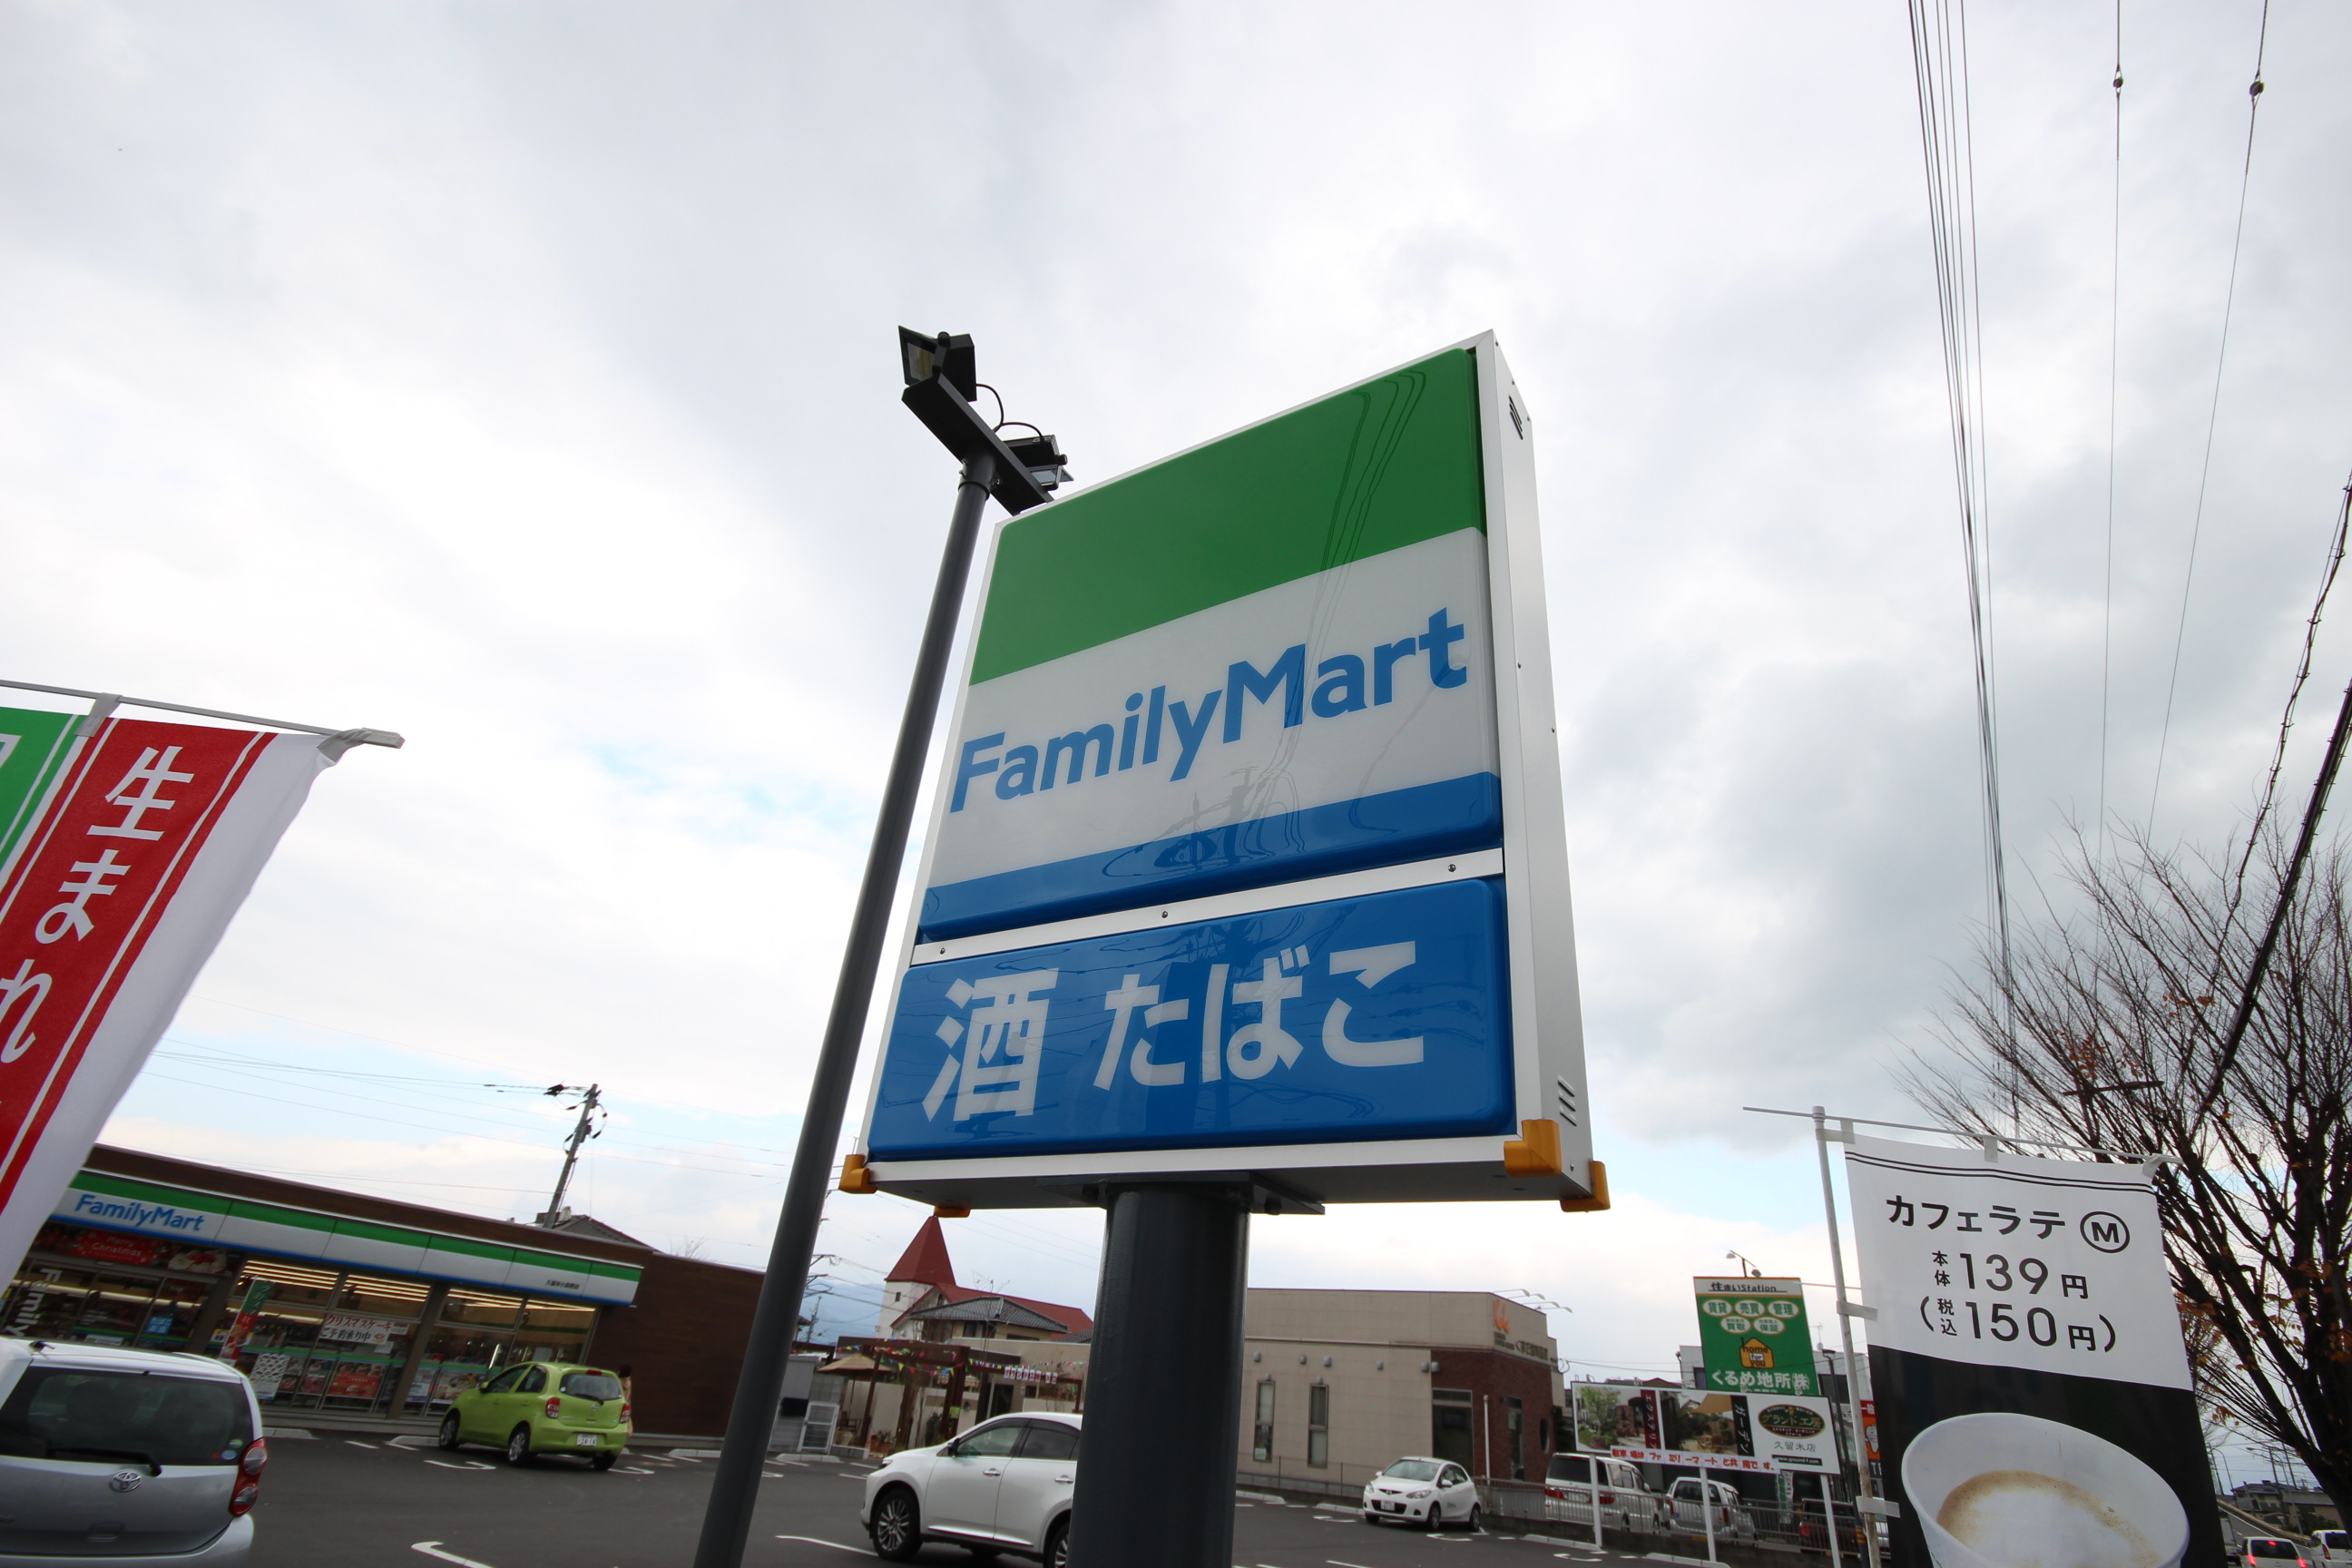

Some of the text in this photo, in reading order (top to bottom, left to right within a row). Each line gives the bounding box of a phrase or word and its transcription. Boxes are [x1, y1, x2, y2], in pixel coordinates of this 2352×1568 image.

[950, 606, 1467, 813] FamilyMart
[922, 941, 1425, 1122] 酒 たばこ
[75, 1194, 205, 1231] FamilyMart
[1886, 1194, 2066, 1240] カフェラテ
[1932, 1250, 2089, 1299] 本体 139円
[327, 1314, 393, 1331] クリスマスケーキ
[1735, 1404, 1750, 1454] ガーデン
[1774, 1441, 1817, 1452] 久留米店
